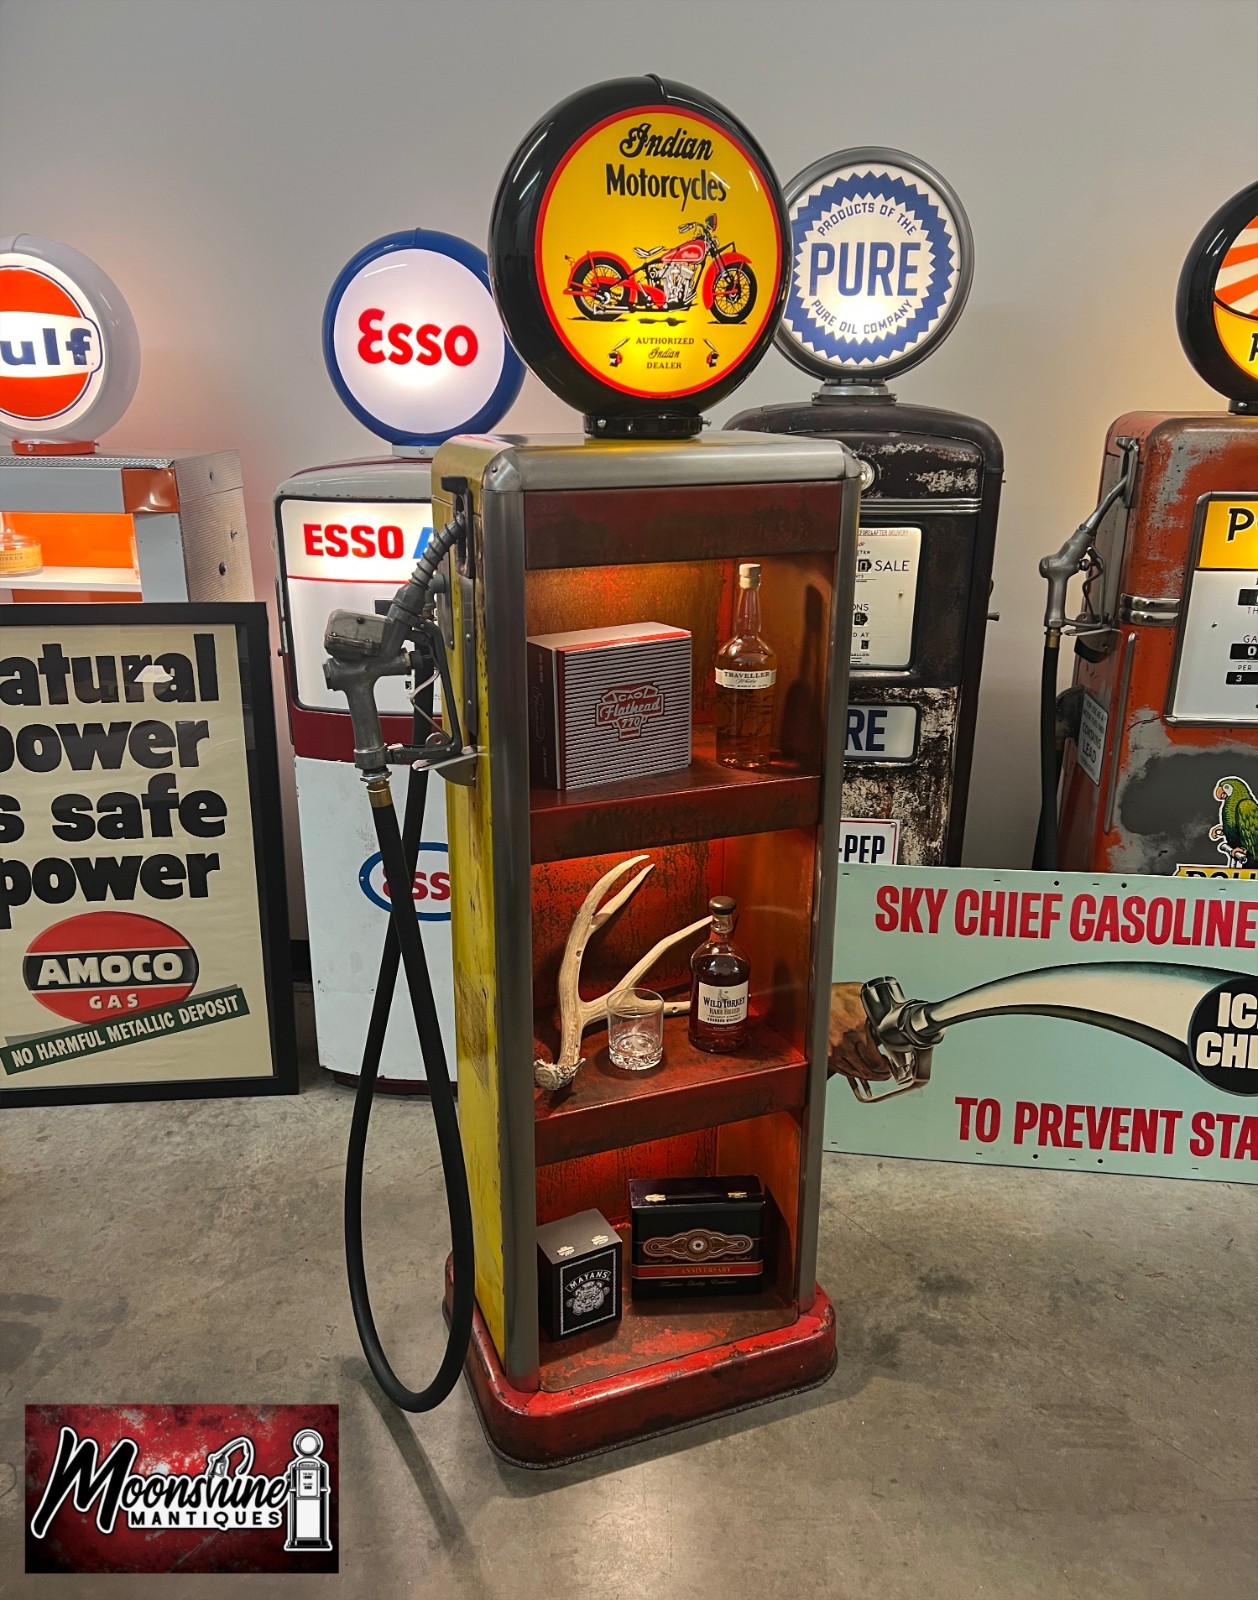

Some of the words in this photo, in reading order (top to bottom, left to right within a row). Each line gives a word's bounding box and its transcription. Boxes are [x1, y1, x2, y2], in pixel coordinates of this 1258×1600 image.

[619, 123, 714, 161] Indian
[605, 163, 727, 212] Motorcycles
[817, 202, 875, 236] PRODUCTS
[879, 204, 896, 217] OF
[897, 213, 917, 235] THE
[808, 242, 922, 297] PURE
[811, 299, 837, 326] PURE
[839, 321, 858, 335] OIL
[863, 299, 913, 335] COMPANY
[635, 337, 695, 345] AUTHORIZED
[648, 347, 680, 359] Indian
[303, 523, 404, 559] ESSO
[874, 559, 910, 571] SALE
[724, 671, 770, 679] TRAVELLER
[1235, 674, 1243, 682] 3
[600, 697, 661, 720] Flathead
[618, 691, 643, 702] CAO
[621, 716, 640, 728] 770
[51, 772, 228, 842] safe
[0, 852, 221, 930] power
[874, 885, 948, 934] SKY
[954, 888, 1063, 939] CHIEF
[1069, 893, 1257, 949] GASOLINE
[37, 952, 184, 986] AMOCO
[89, 993, 139, 1010] GAS
[703, 996, 722, 1008] WILD
[722, 996, 745, 1008] TURKEY
[1218, 992, 1258, 1029] IC
[11, 1047, 34, 1068] NO
[35, 1030, 105, 1061] HARMFUL
[106, 1012, 175, 1043] METALLIC
[178, 994, 239, 1025] DEPOSIT
[954, 1096, 1001, 1143] TO
[1013, 1102, 1183, 1155] PREVENT
[570, 1271, 608, 1289] MAYANS
[680, 1266, 731, 1274] ANNIVERSARY
